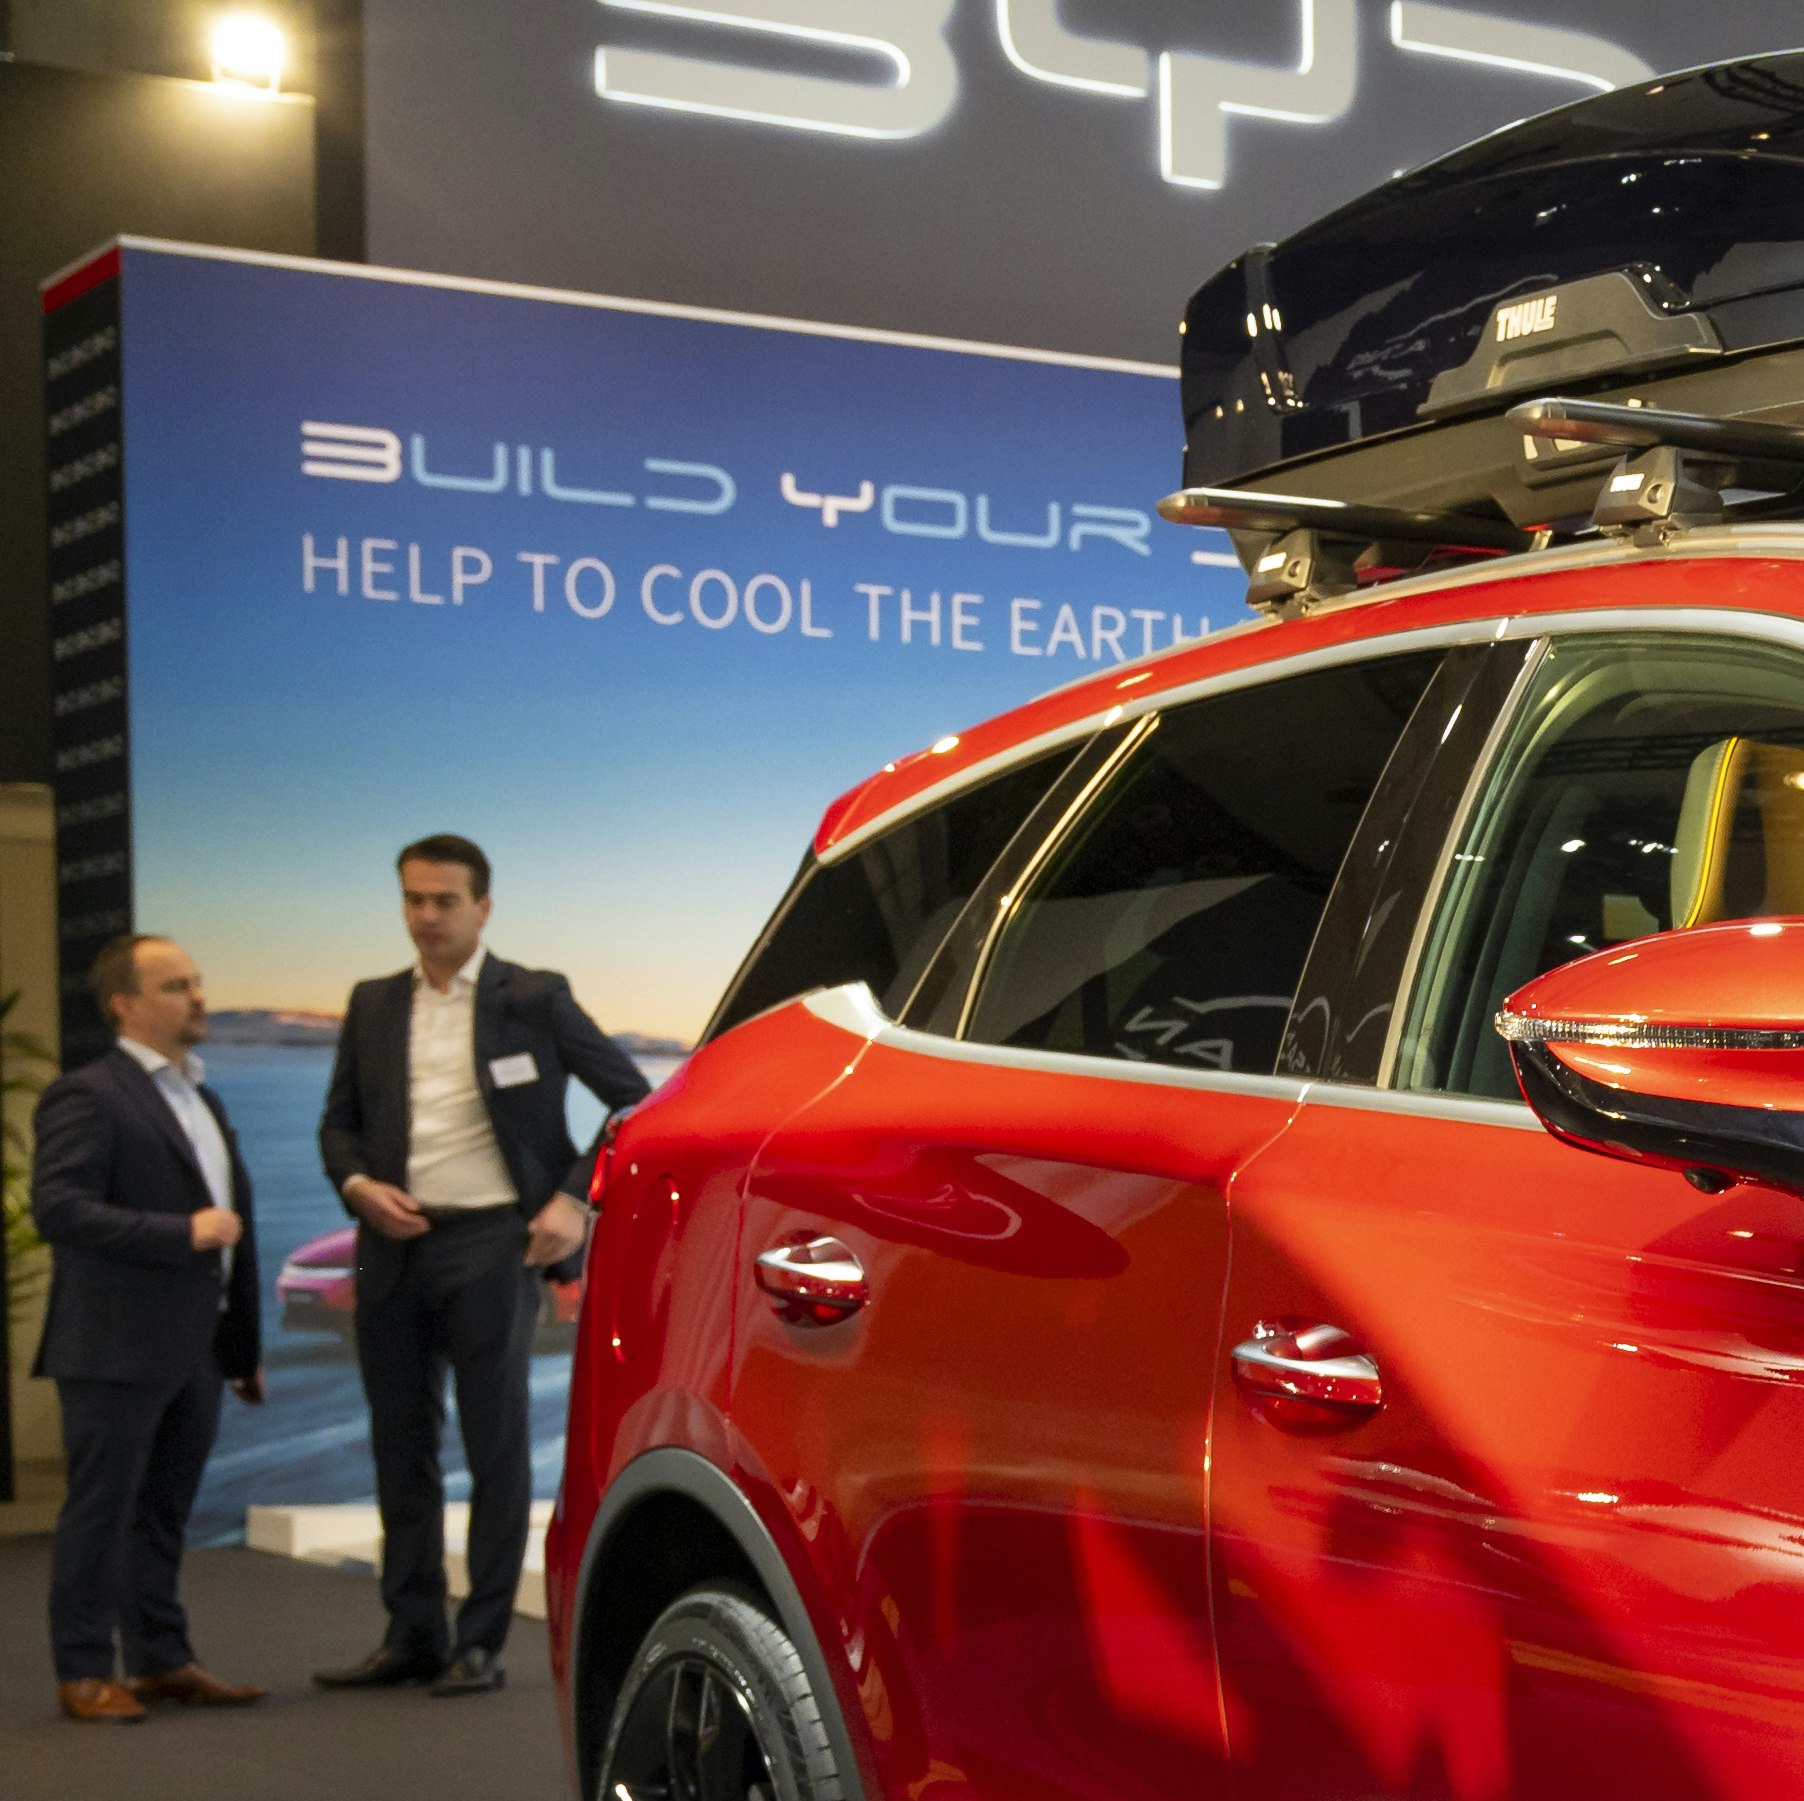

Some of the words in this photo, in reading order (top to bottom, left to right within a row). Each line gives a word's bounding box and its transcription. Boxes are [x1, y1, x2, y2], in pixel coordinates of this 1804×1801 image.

[1496, 295, 1557, 342] THULE
[300, 420, 737, 515] BUILD
[780, 472, 1152, 557] YOUR
[302, 532, 493, 605] HELP
[517, 550, 616, 618] TO
[641, 563, 833, 639] COOL
[853, 582, 984, 652] THE
